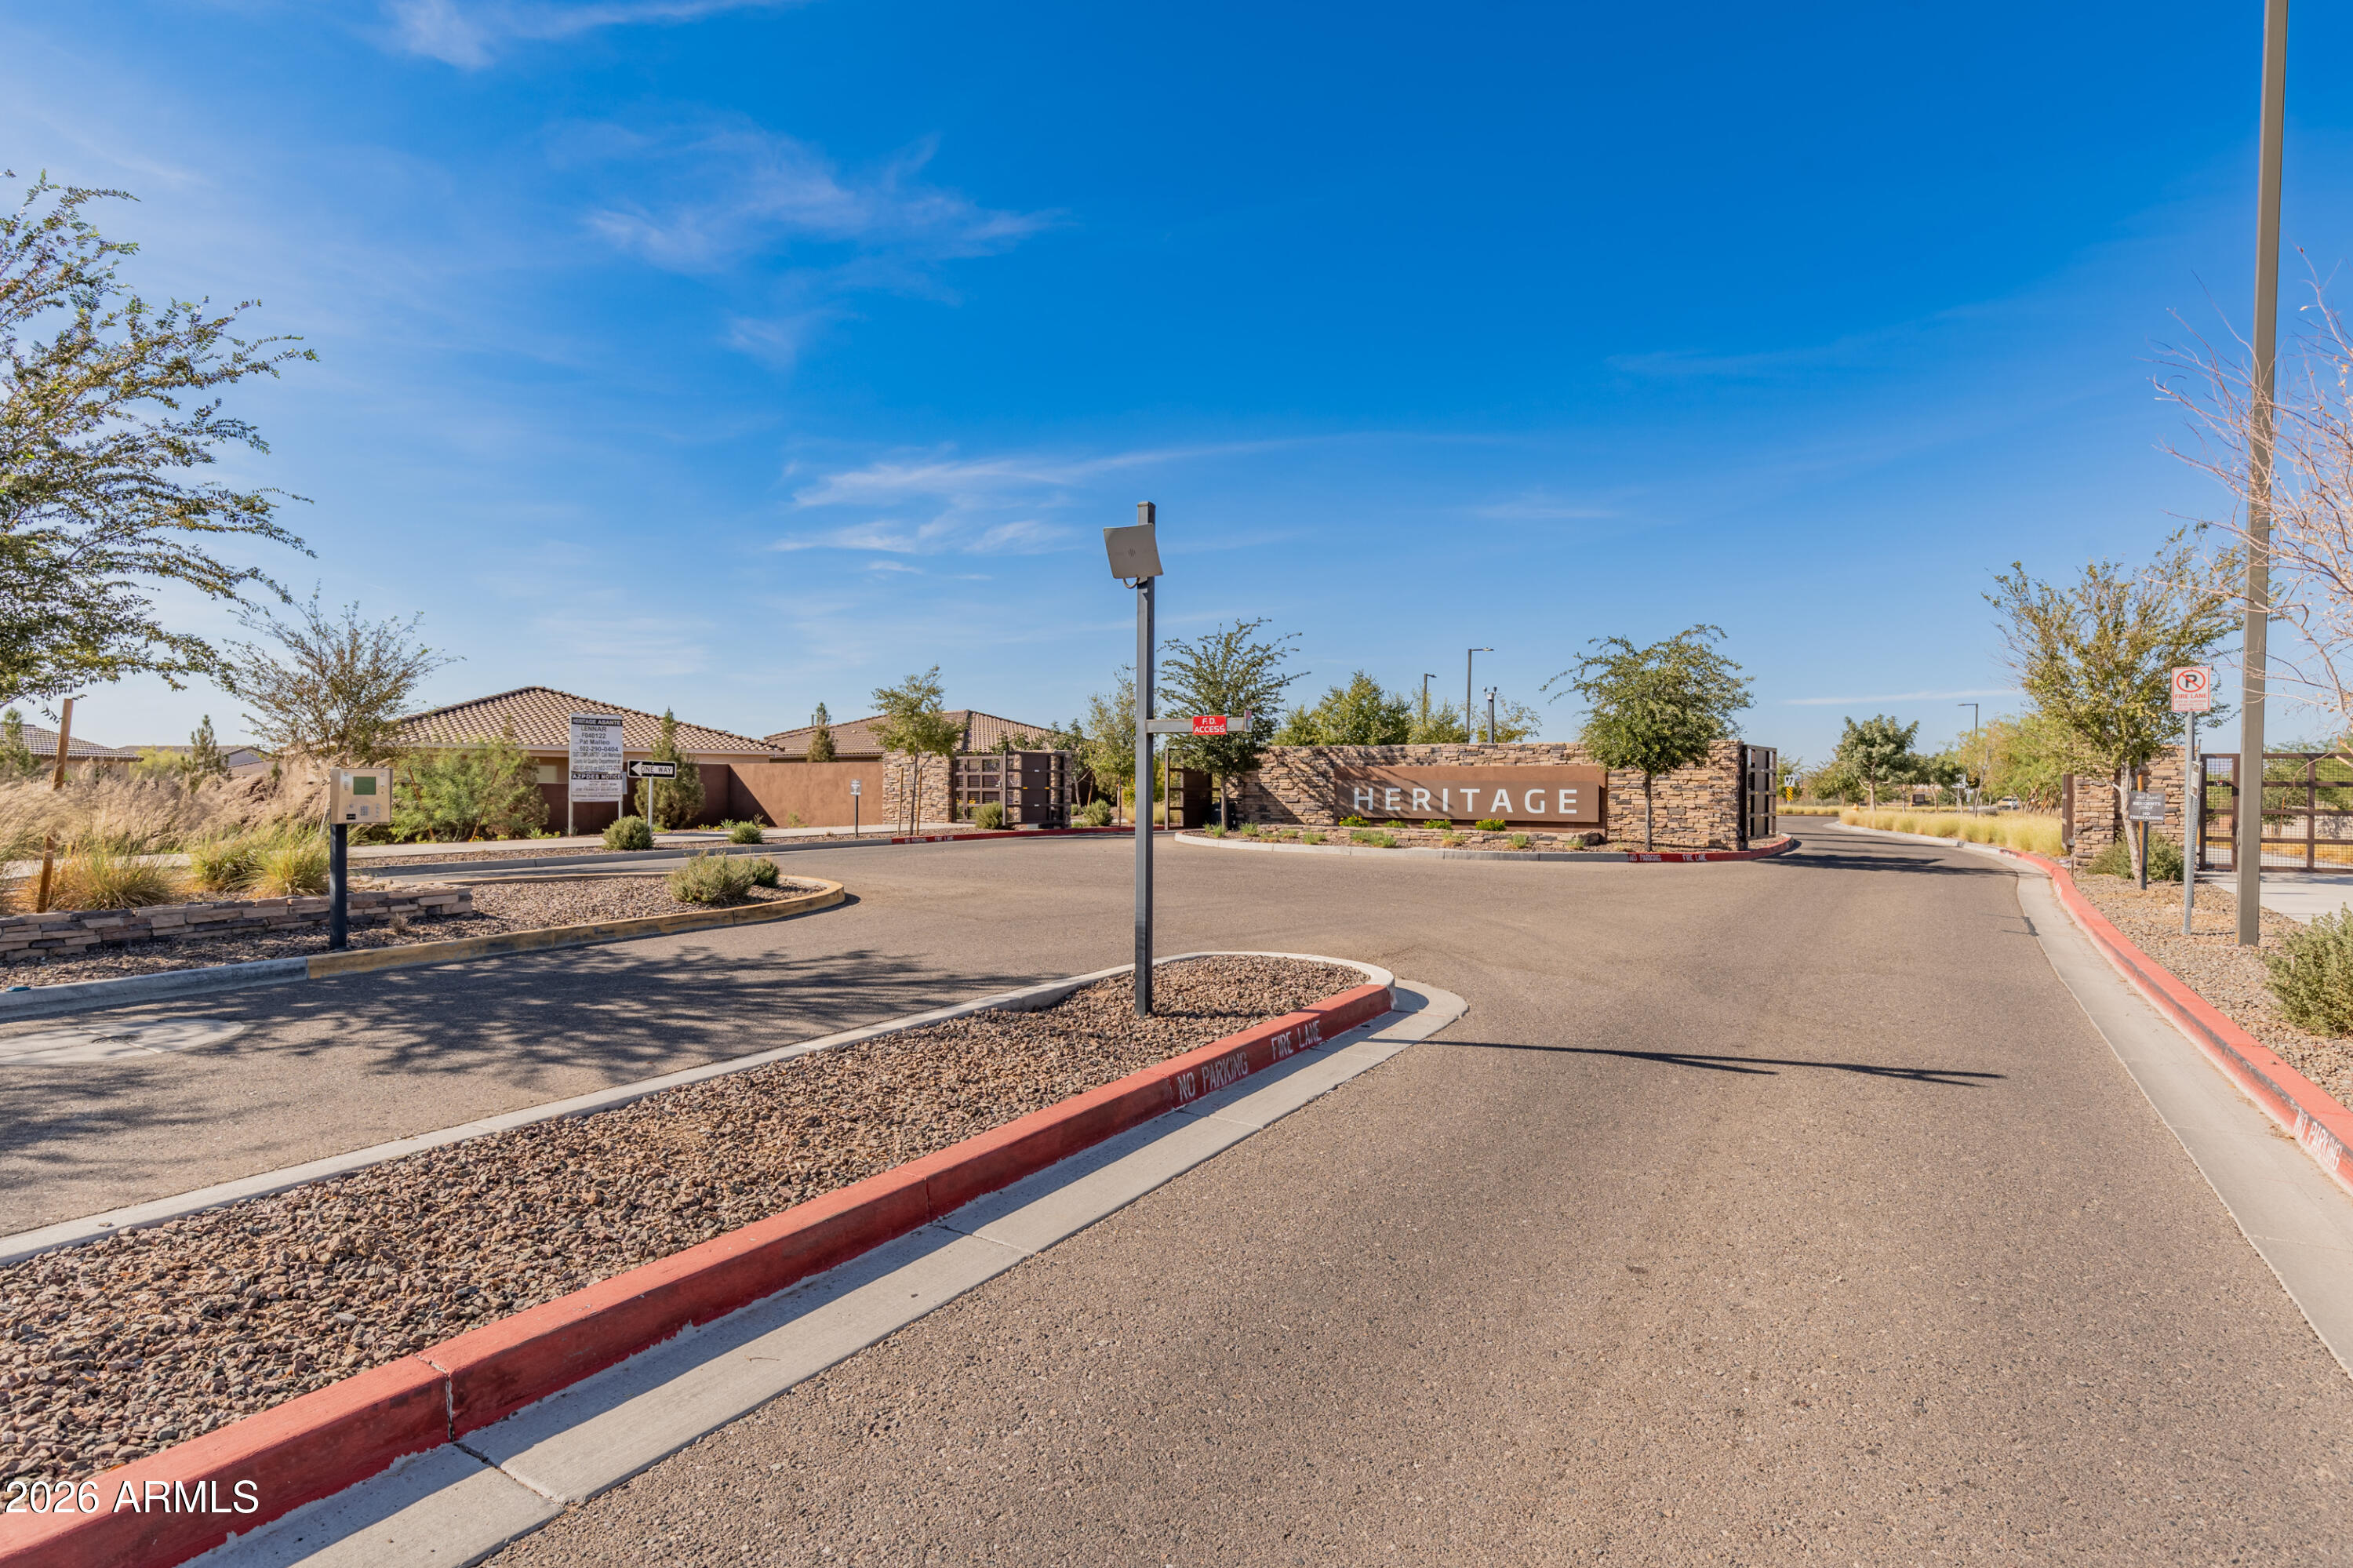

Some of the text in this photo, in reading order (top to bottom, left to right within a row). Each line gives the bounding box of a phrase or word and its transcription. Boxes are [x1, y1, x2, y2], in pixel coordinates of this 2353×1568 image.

[1354, 788, 1578, 814] HERITAGE
[1176, 1020, 1322, 1103] NO PARKING FIRE LANE
[2293, 1109, 2343, 1170] NO PARKING
